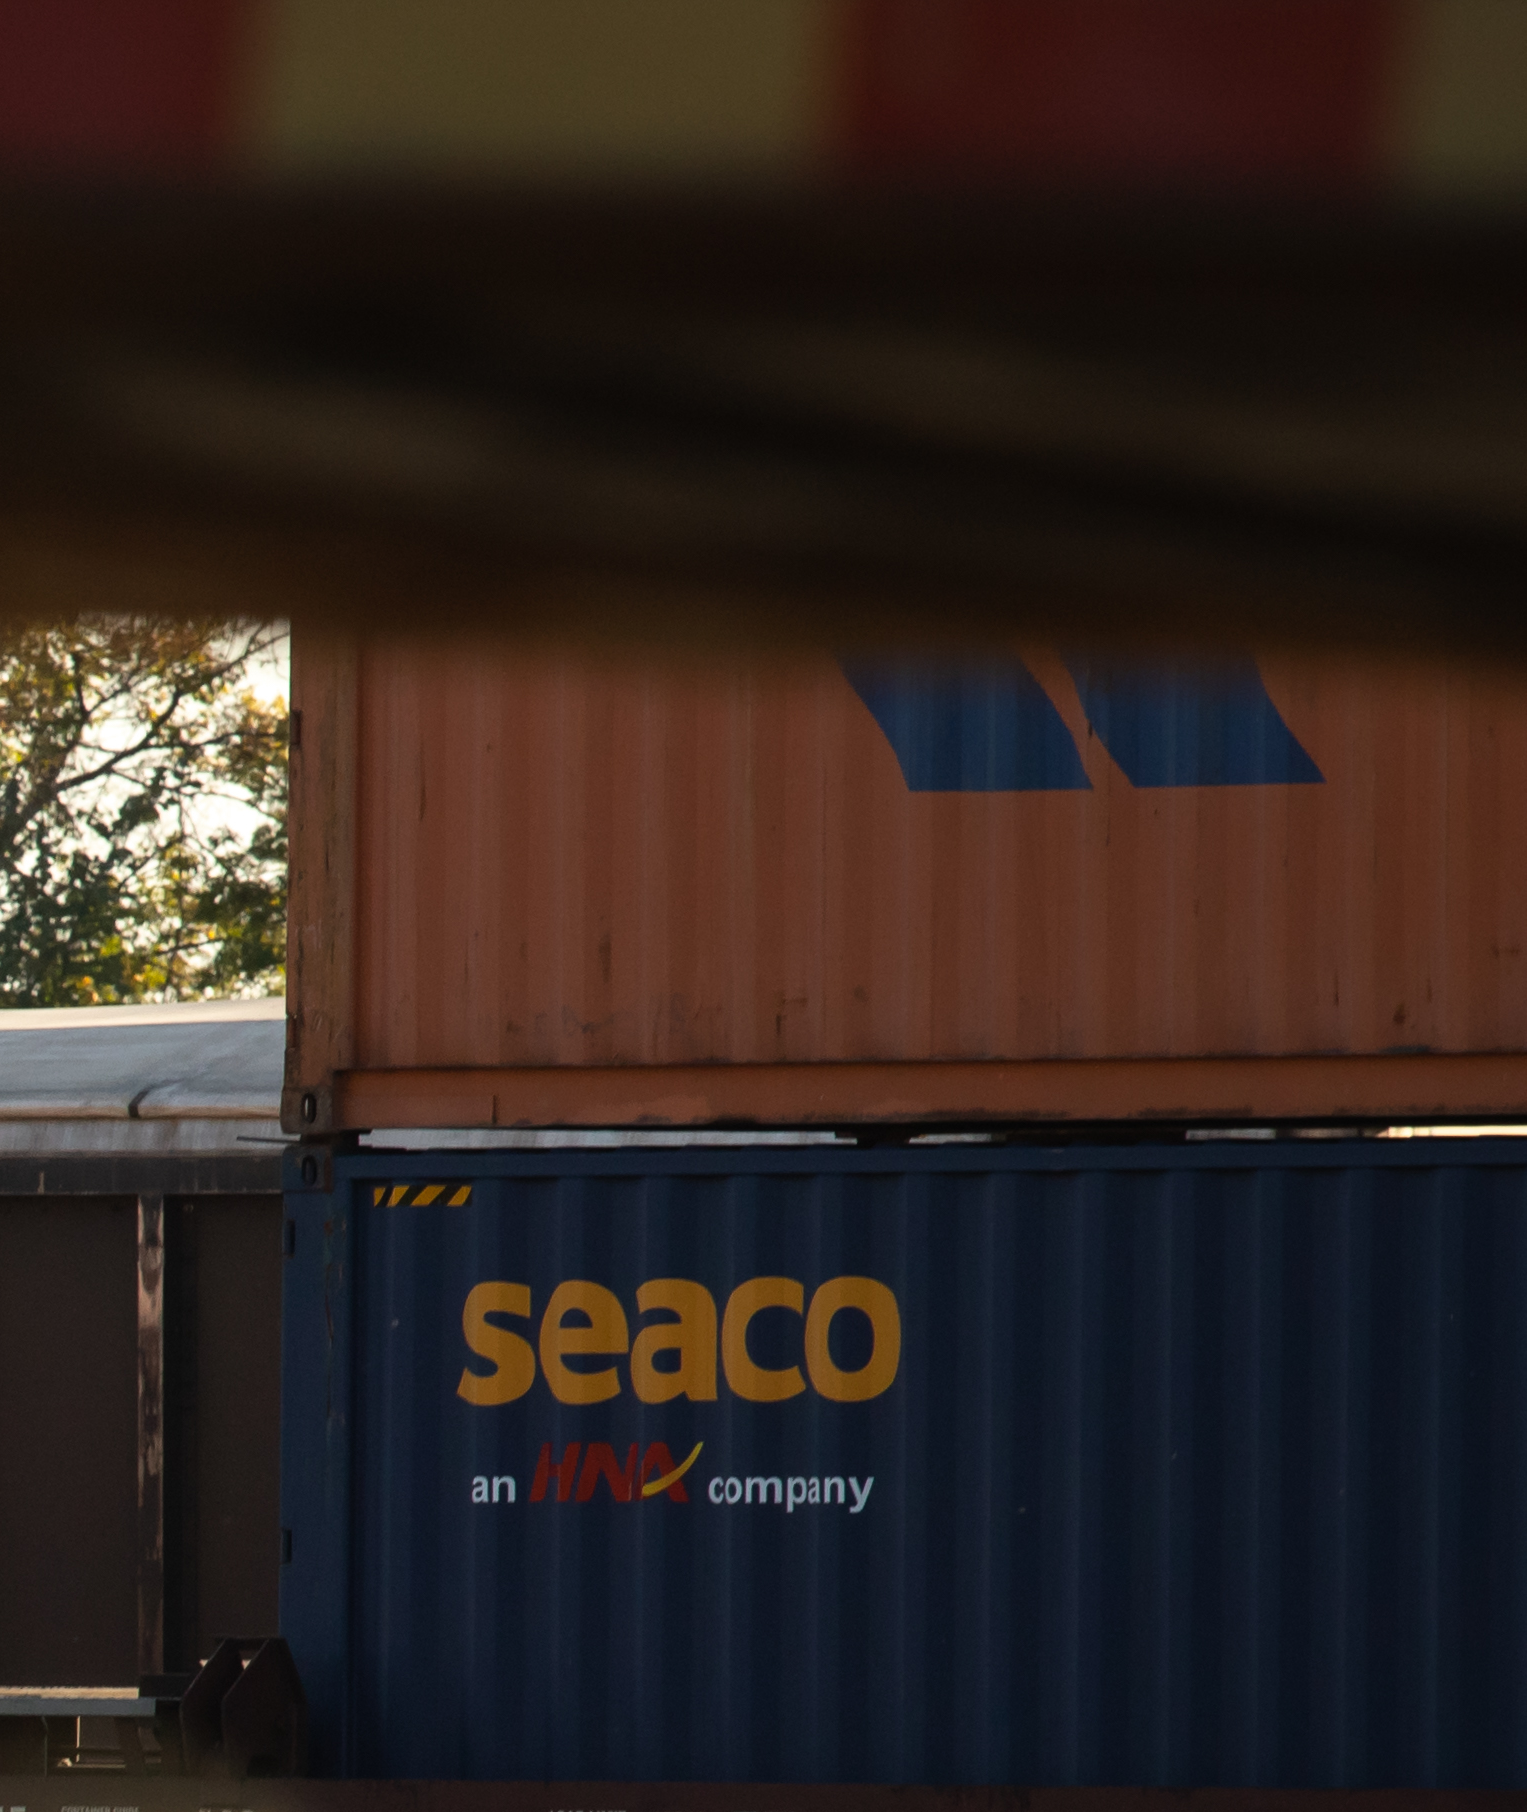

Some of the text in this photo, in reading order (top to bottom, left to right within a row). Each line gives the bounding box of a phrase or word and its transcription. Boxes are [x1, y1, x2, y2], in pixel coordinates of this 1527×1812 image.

[456, 1275, 901, 1406] seaco
[471, 1441, 874, 1514] an HNA company
